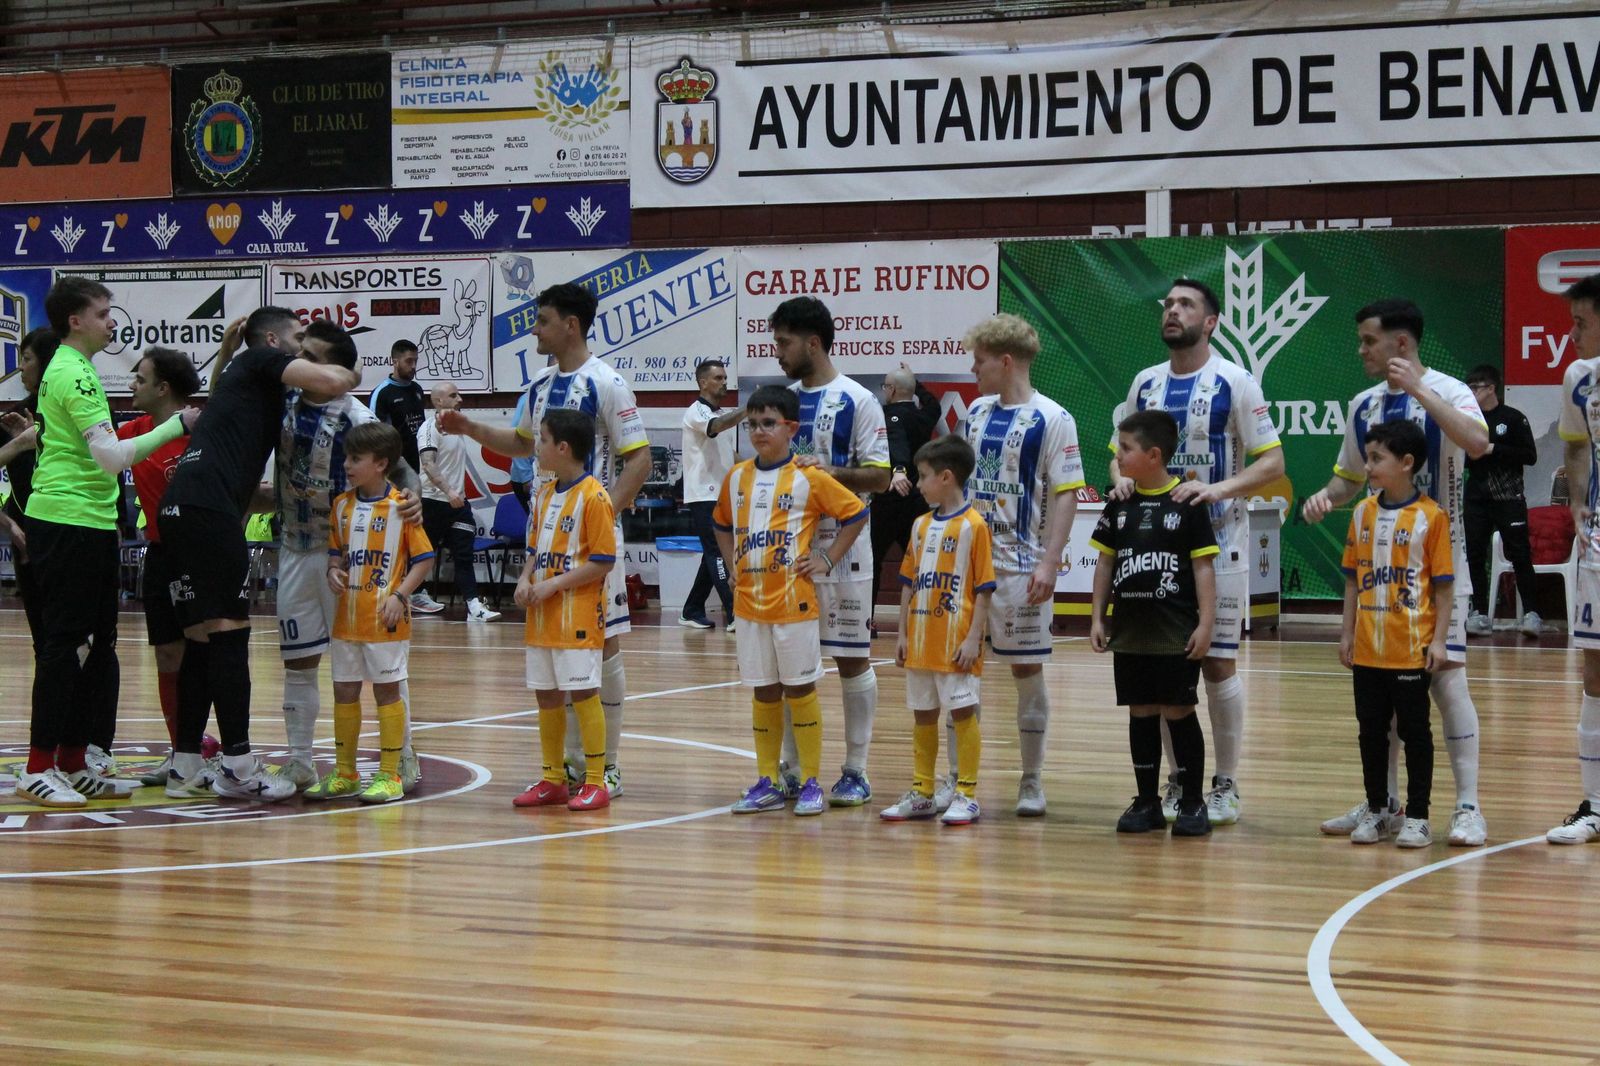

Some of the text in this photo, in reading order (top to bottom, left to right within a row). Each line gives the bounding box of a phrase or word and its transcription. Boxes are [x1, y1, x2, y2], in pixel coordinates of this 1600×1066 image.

[400, 57, 467, 72] CLÍNICA
[400, 71, 523, 89] FISIOTERAPIA
[272, 81, 385, 103] CLUB DE TIRO
[401, 90, 490, 105] INTEGRAL
[748, 41, 1600, 150] AYUNTAMIENTO DE BENAV
[294, 113, 369, 132] EL JARAL
[0, 104, 147, 167] KTM
[549, 122, 610, 143] LUISA VILLAR
[397, 153, 441, 161] REHABILITACIÓN
[450, 146, 495, 154] REHABILITACIÓN
[208, 214, 240, 229] AMOR
[246, 242, 309, 254] CAJA RURAL
[104, 271, 139, 280] MOVIMIENTO
[140, 271, 147, 279] DE
[176, 270, 195, 279] PLANTA
[196, 270, 204, 278] DE
[279, 267, 442, 290] TRANSPORTES
[745, 265, 990, 296] GARAJE RUFINO
[508, 253, 653, 337] FETERIA
[294, 302, 360, 328] ESUS
[834, 315, 902, 331] OFICIAL
[0, 321, 19, 331] VENTE
[831, 337, 967, 356] TRUCKS ESPAÑA
[1521, 326, 1570, 368] Fy
[614, 356, 637, 369] Tel.
[644, 356, 666, 369] 980
[672, 356, 687, 369] 63
[634, 372, 698, 382] BENAVEN
[1265, 400, 1352, 435] URA
[983, 480, 1024, 496] RURAL
[735, 530, 793, 565] CLEMENTE
[347, 549, 391, 569] MENTE
[473, 553, 527, 564] BENAVEN
[1581, 603, 1593, 628] 4
[280, 619, 299, 641] 10
